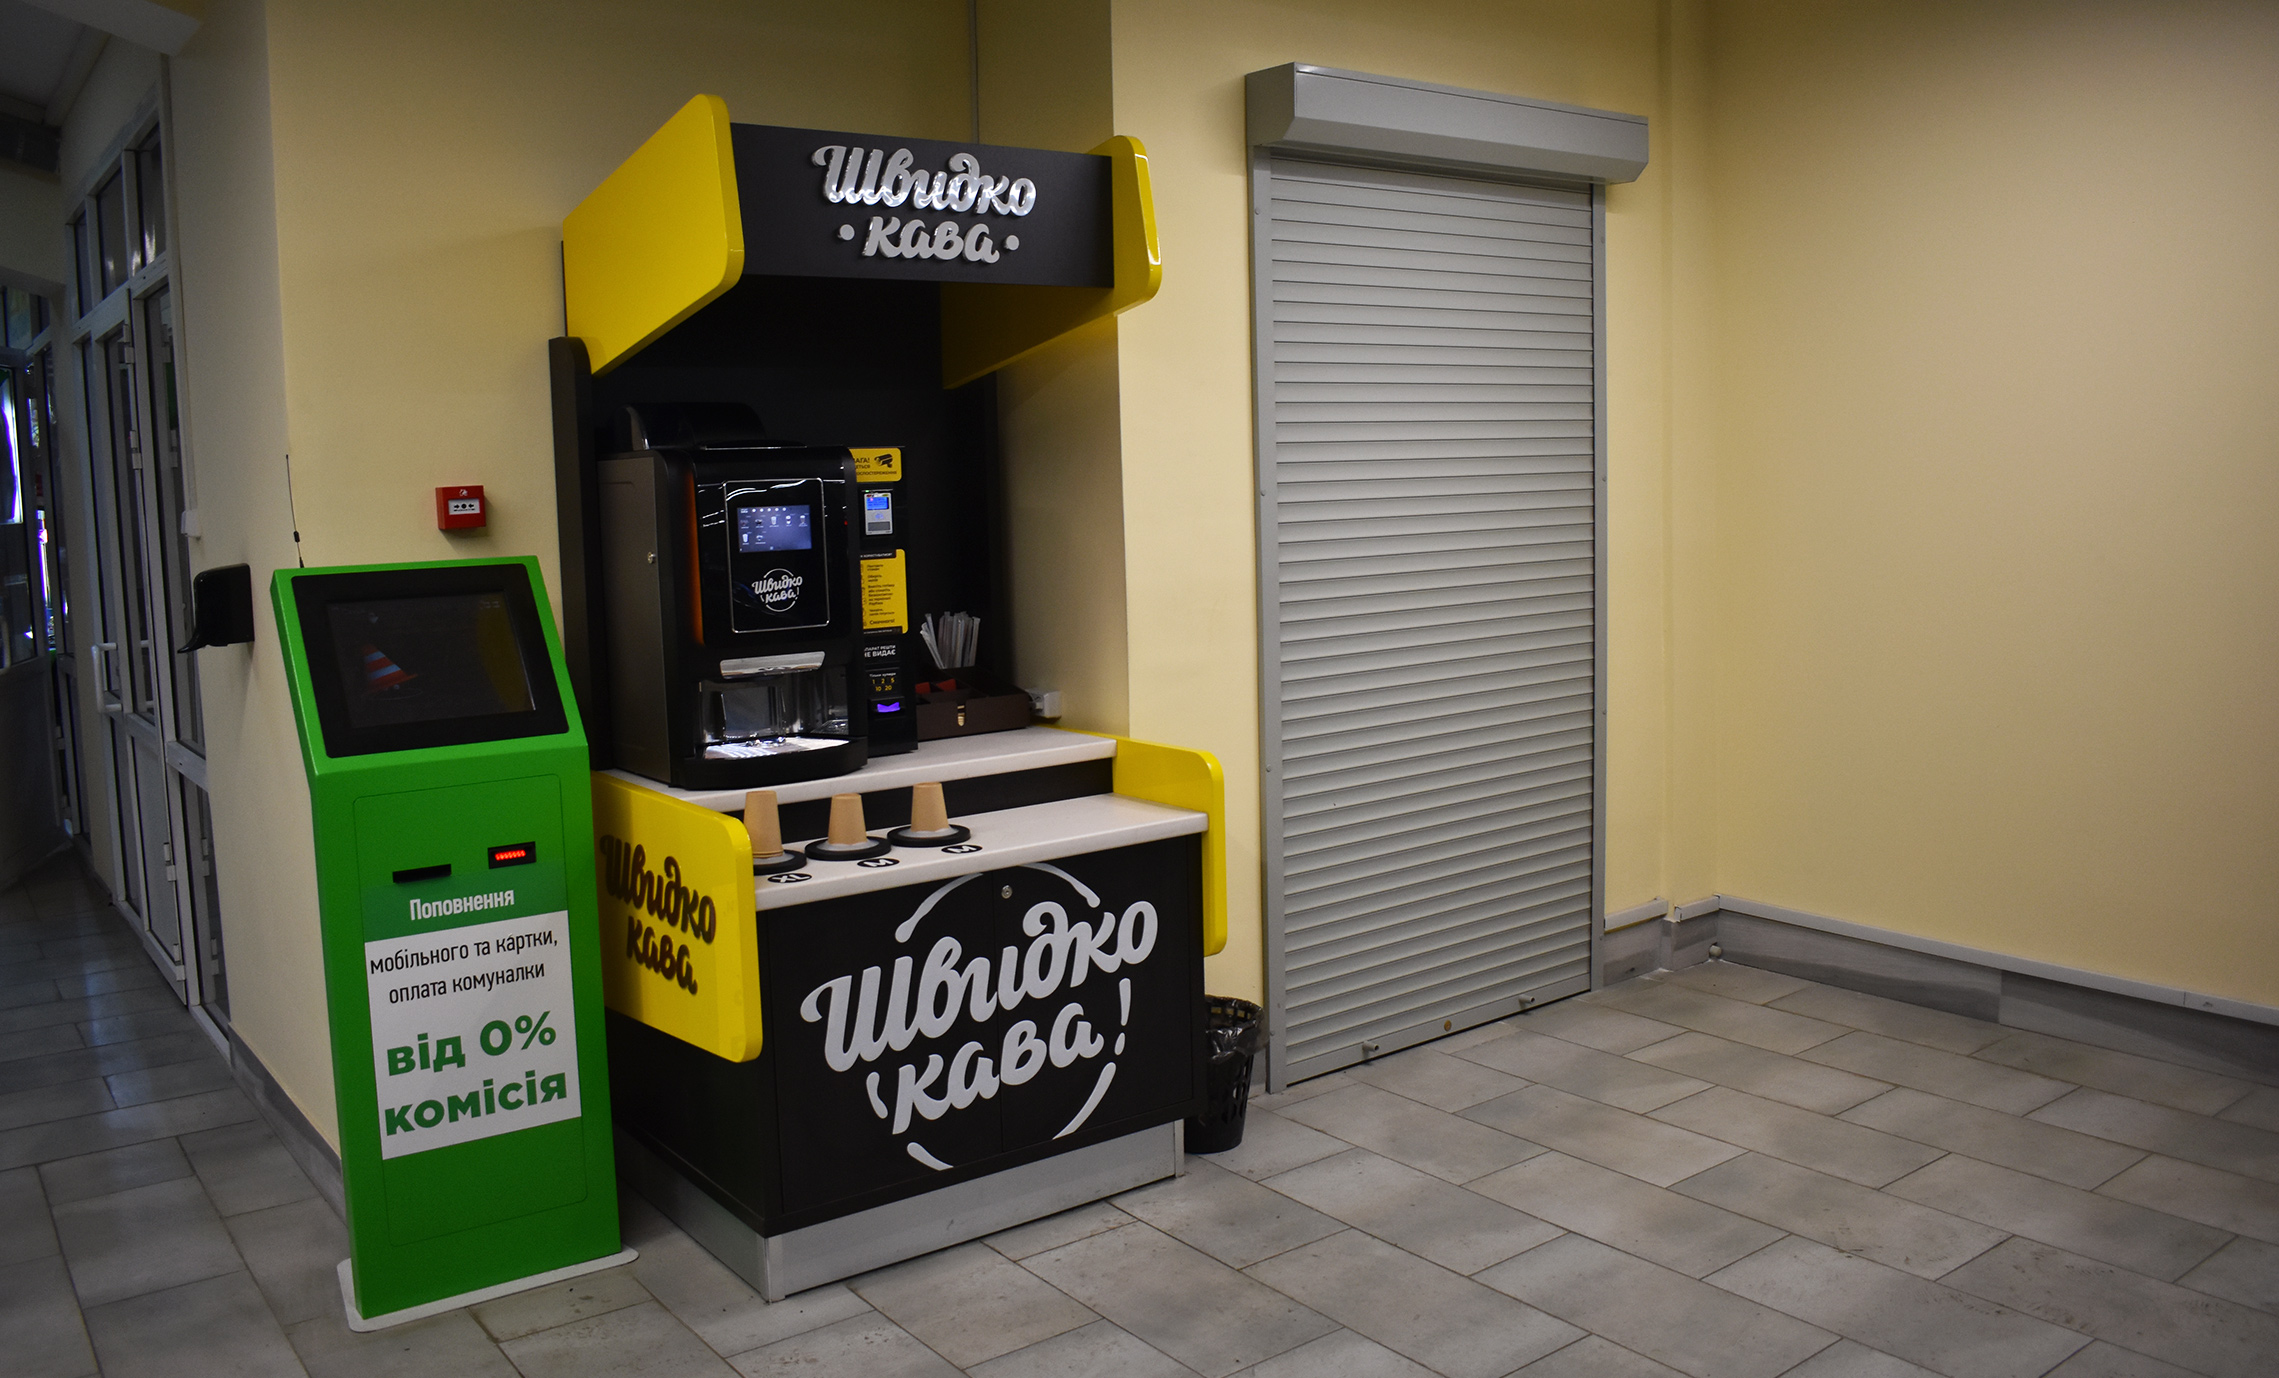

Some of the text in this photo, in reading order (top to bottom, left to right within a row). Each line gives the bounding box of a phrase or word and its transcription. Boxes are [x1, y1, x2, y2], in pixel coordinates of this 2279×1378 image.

[811, 145, 1037, 217] Швидко
[861, 216, 1000, 264] кава
[751, 574, 803, 594] Швидко
[765, 587, 799, 604] кава!
[863, 858, 894, 867] M
[947, 844, 977, 854] M
[600, 834, 716, 945] Швидко
[771, 873, 809, 883] XL
[409, 889, 515, 921] Поповнення
[370, 930, 558, 975] мобільного та картки,
[627, 915, 698, 995] кава
[388, 962, 545, 1004] оплата комуналки
[800, 901, 1158, 1072] Швидко
[387, 1010, 556, 1077] від 0%
[892, 977, 1131, 1135] кава!
[384, 1069, 567, 1136] комісія
